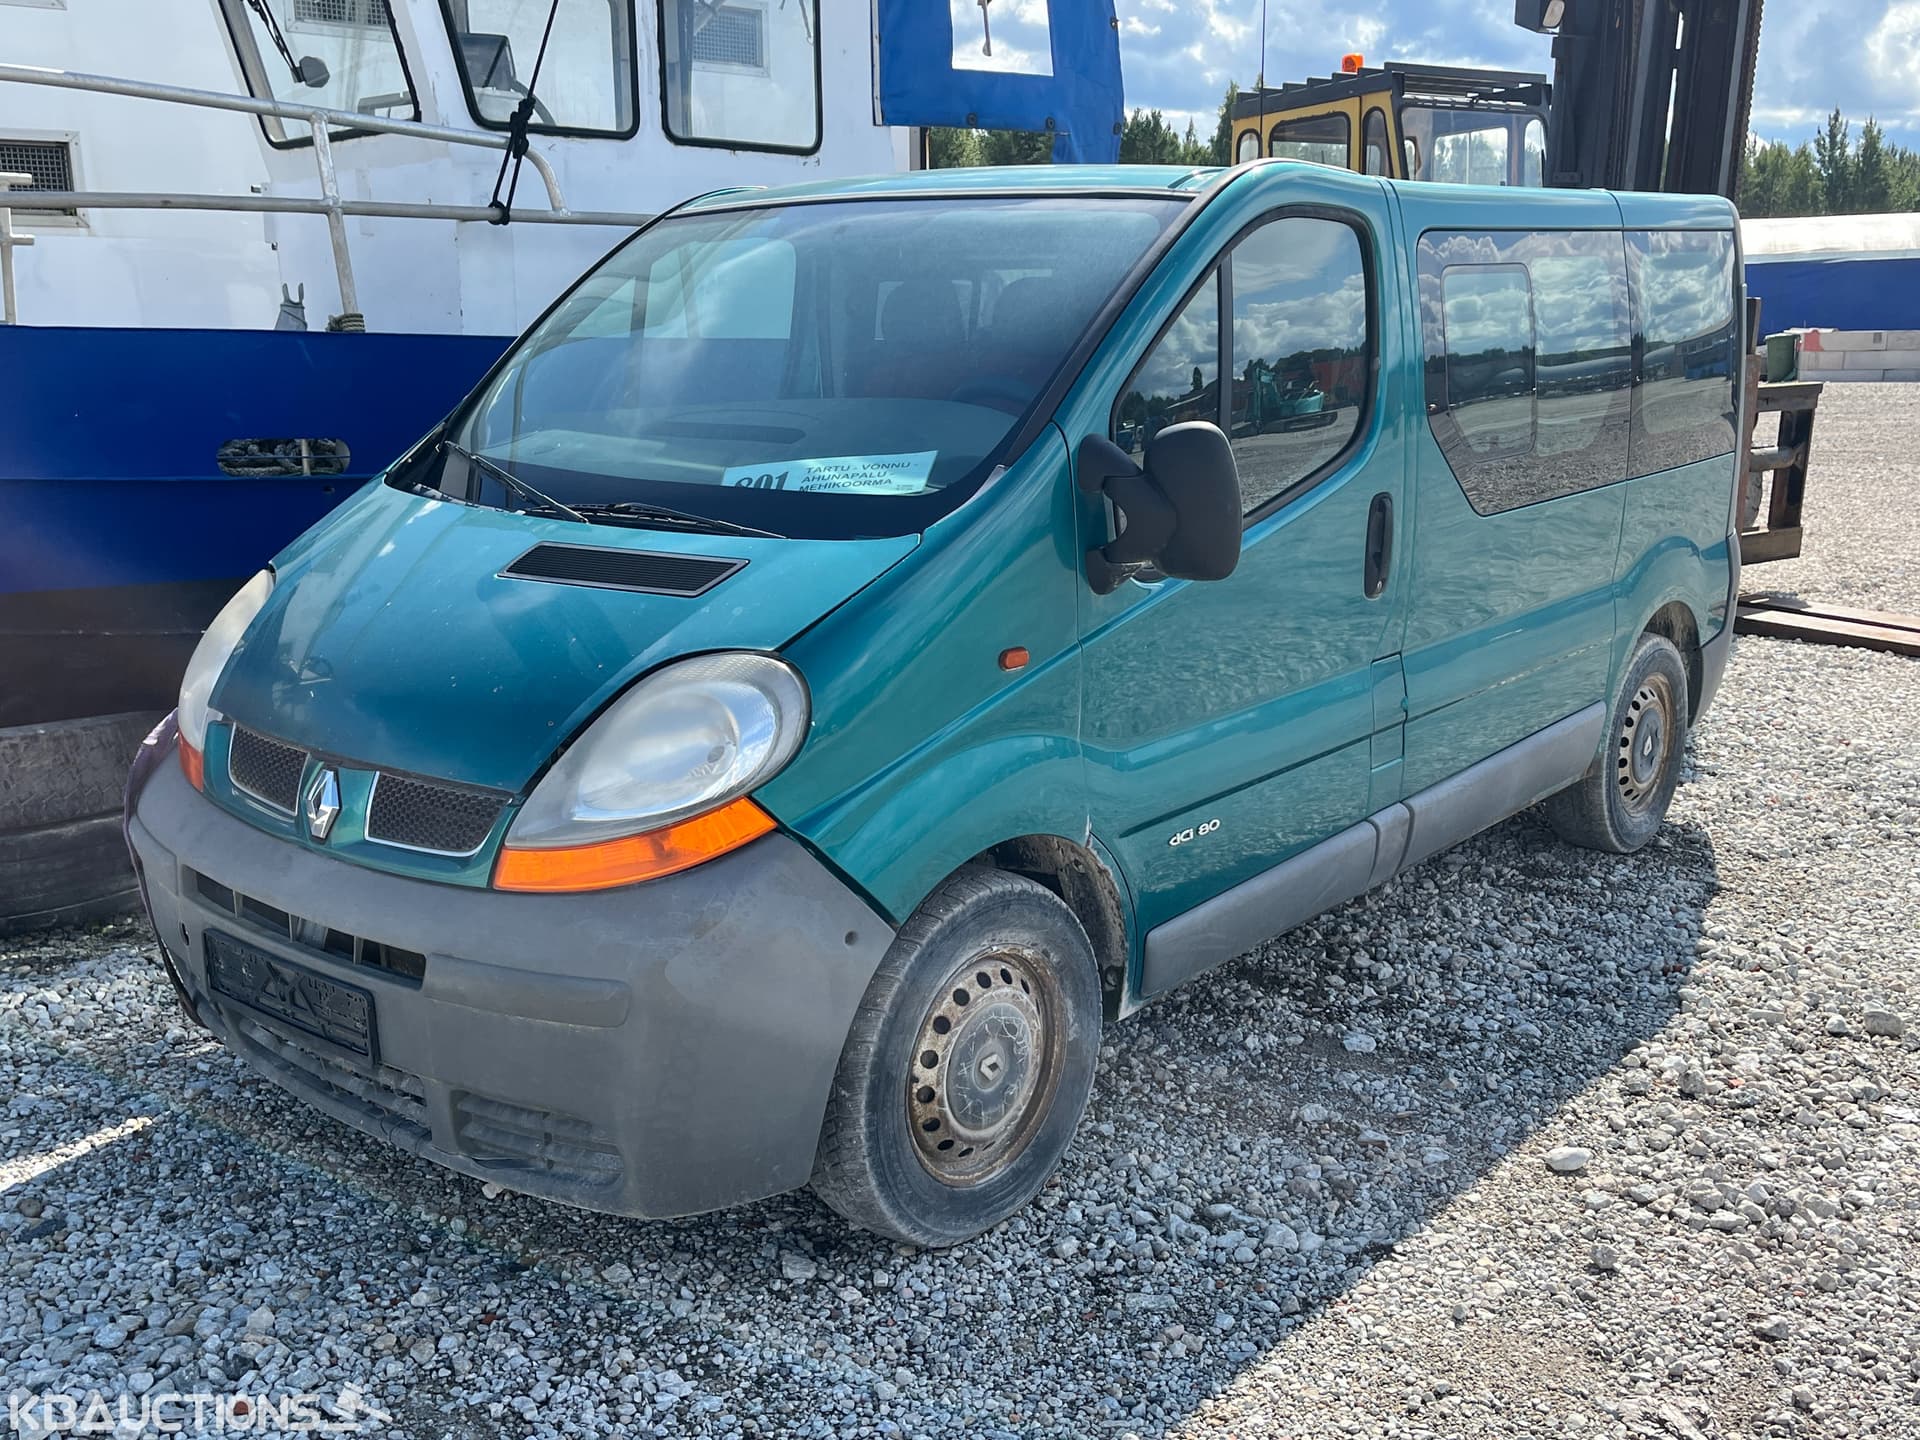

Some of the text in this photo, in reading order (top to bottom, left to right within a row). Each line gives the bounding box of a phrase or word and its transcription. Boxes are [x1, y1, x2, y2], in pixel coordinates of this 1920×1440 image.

[806, 465, 850, 474] TARTU
[801, 471, 887, 484] AHUNAPALU
[800, 478, 892, 493] MEHIKOORMA
[1198, 819, 1221, 836] 80
